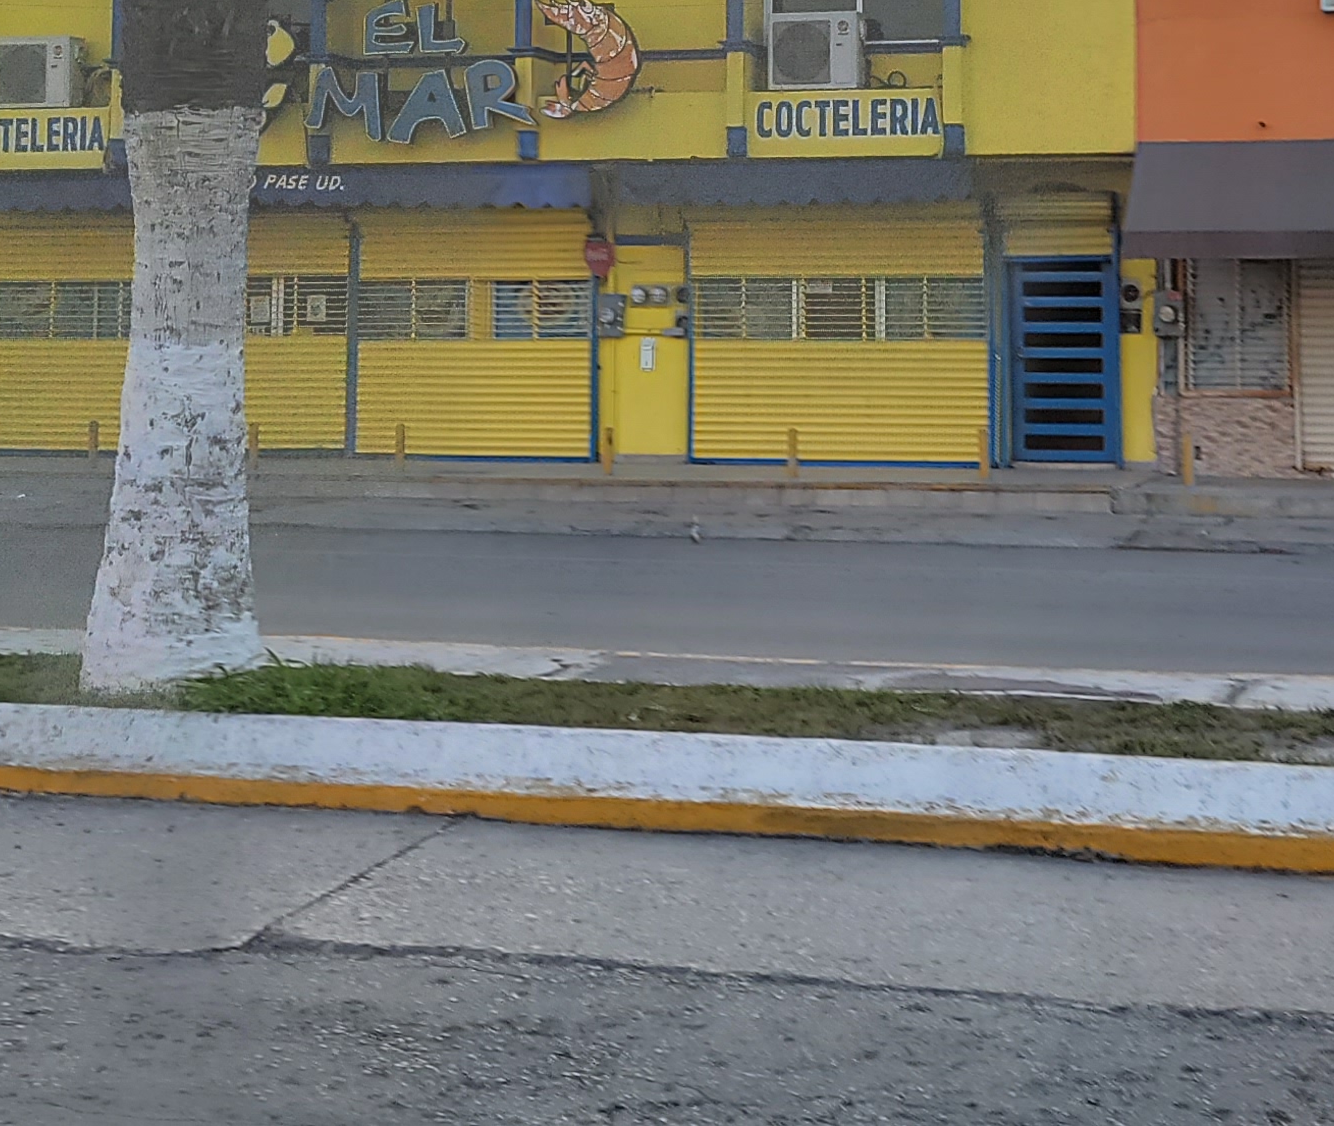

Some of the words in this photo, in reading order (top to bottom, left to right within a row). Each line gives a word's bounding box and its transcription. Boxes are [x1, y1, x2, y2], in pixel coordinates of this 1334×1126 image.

[303, 59, 540, 145] MAR
[756, 96, 941, 139] COCTELERIA
[263, 174, 309, 191] PASE
